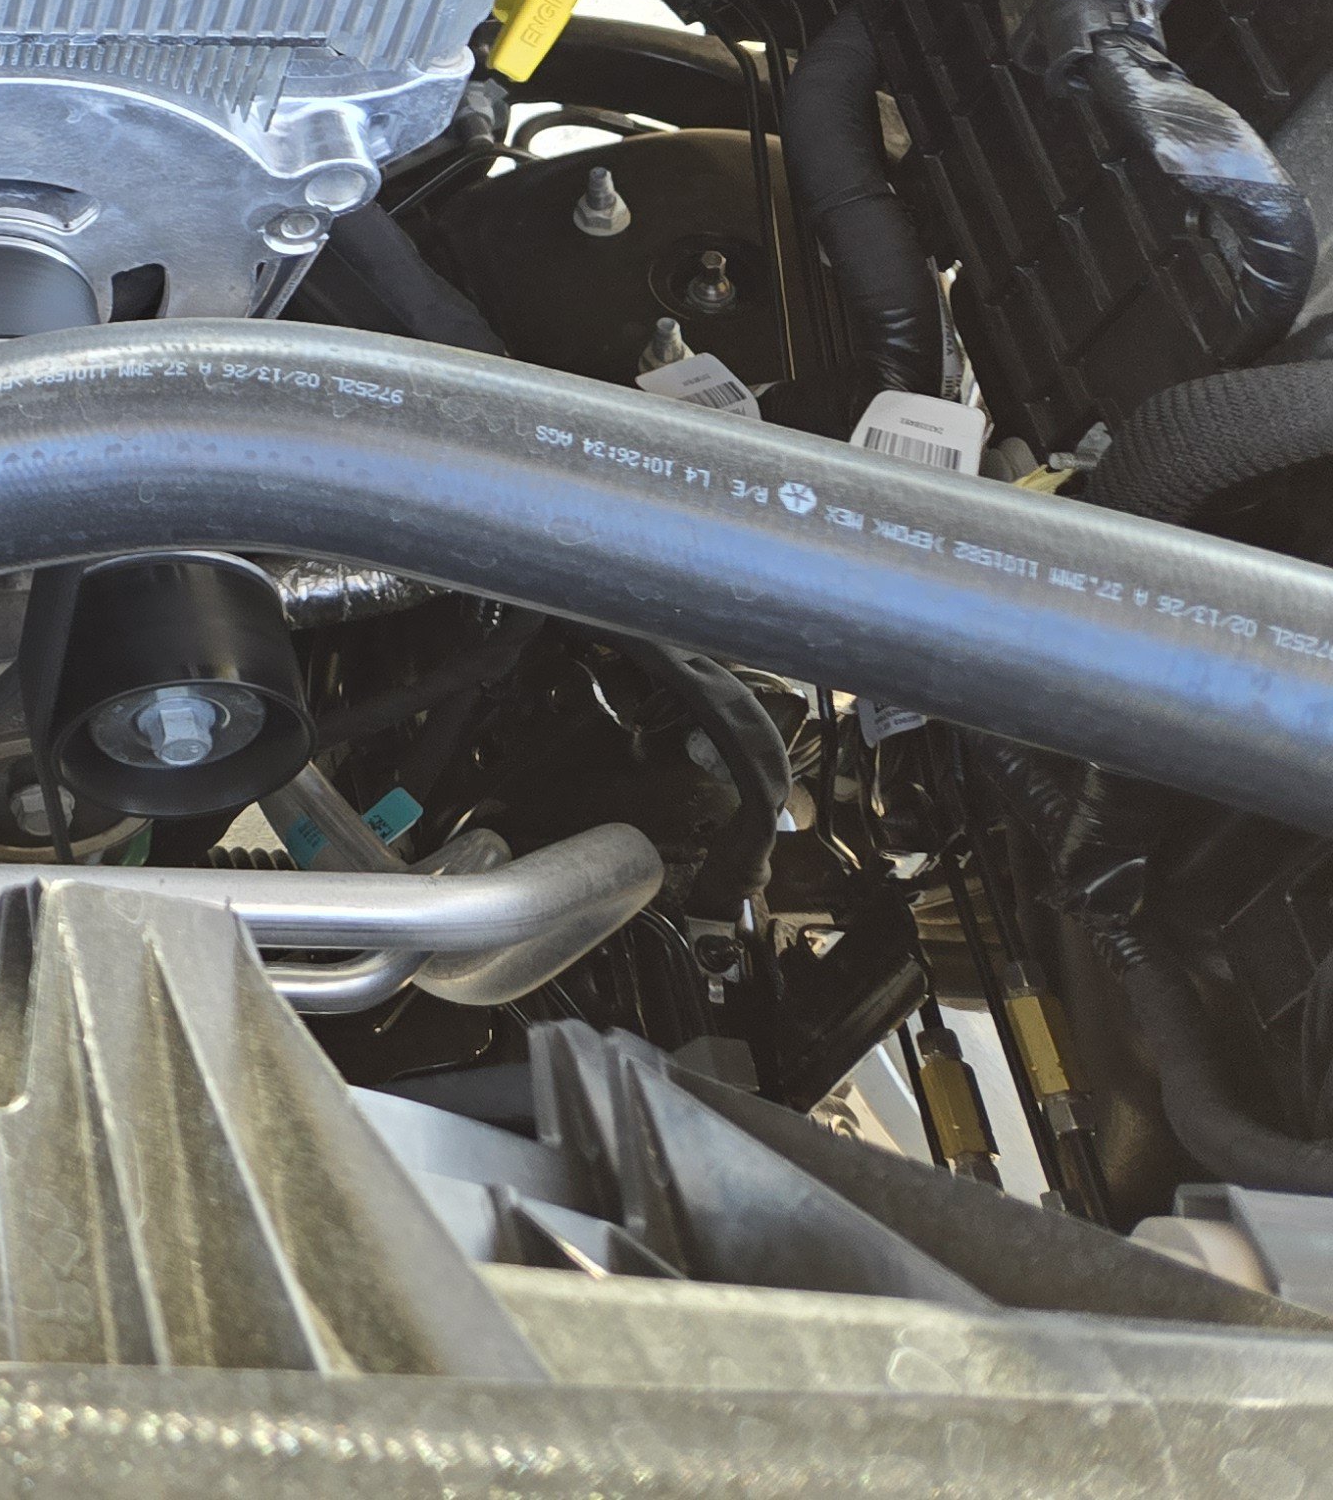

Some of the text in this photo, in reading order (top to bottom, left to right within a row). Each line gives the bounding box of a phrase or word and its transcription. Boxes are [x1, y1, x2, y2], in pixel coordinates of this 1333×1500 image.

[117, 360, 188, 379] 37.3MM
[198, 363, 212, 376] A
[223, 363, 320, 388] 02/13/26
[331, 376, 405, 404] 97252L
[533, 422, 575, 449] AGS
[578, 435, 675, 478] 10:26:34
[681, 463, 712, 488] L4
[728, 477, 771, 505] R/E
[1130, 586, 1150, 608] A
[1153, 592, 1260, 640] 02/13/26
[1265, 623, 1333, 658] 7252L
